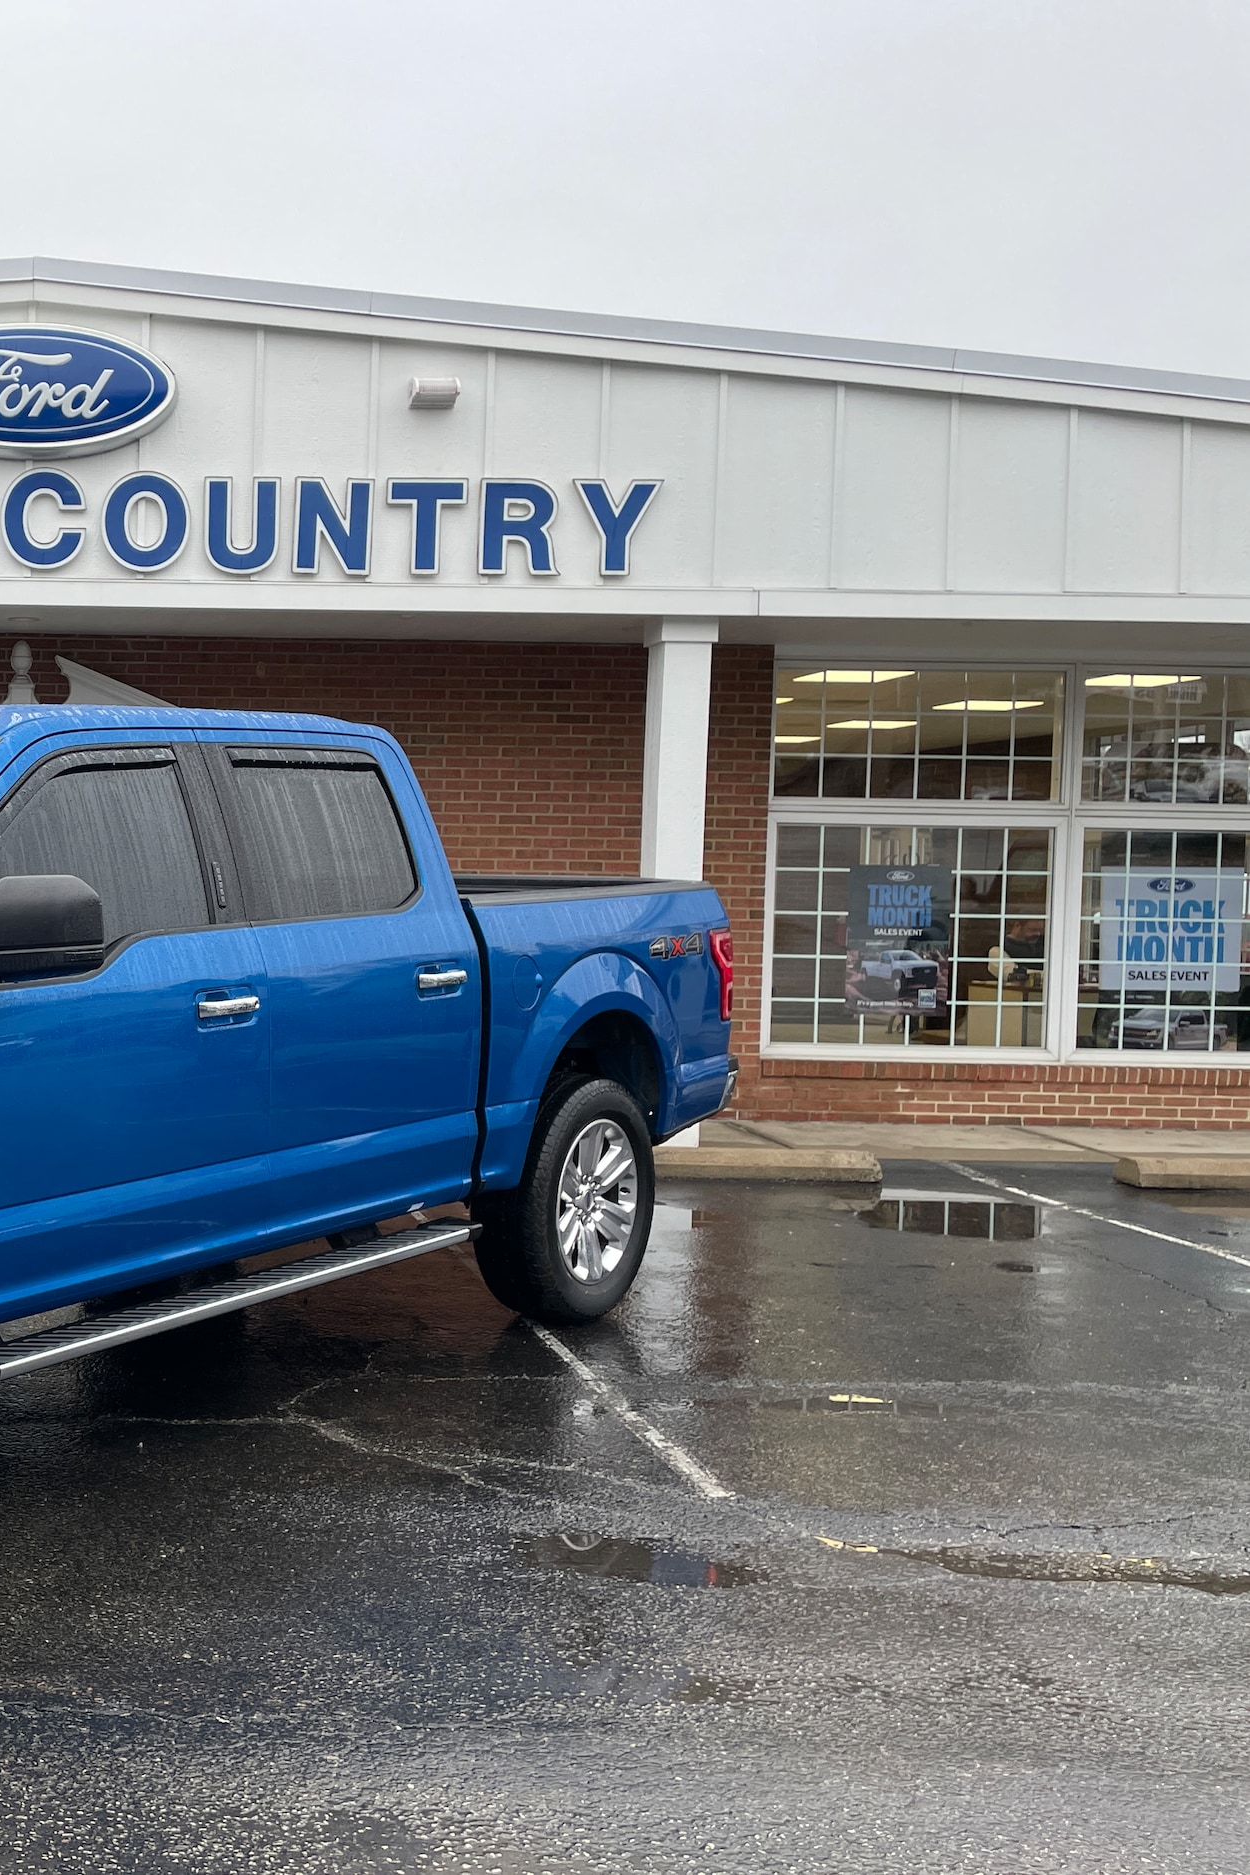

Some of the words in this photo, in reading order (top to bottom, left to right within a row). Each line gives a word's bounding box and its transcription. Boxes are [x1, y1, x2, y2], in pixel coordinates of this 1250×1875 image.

[0, 467, 664, 577] COUNTRY
[867, 884, 932, 907] TRUCK
[1156, 879, 1186, 891] Fod
[867, 907, 932, 927] MONTH
[1115, 899, 1225, 934] TRUCK
[874, 928, 898, 936] SALES
[898, 928, 923, 937] EVENT
[1117, 935, 1225, 964] MONTH
[1127, 970, 1167, 981] SALES
[1170, 971, 1210, 981] EVENT
